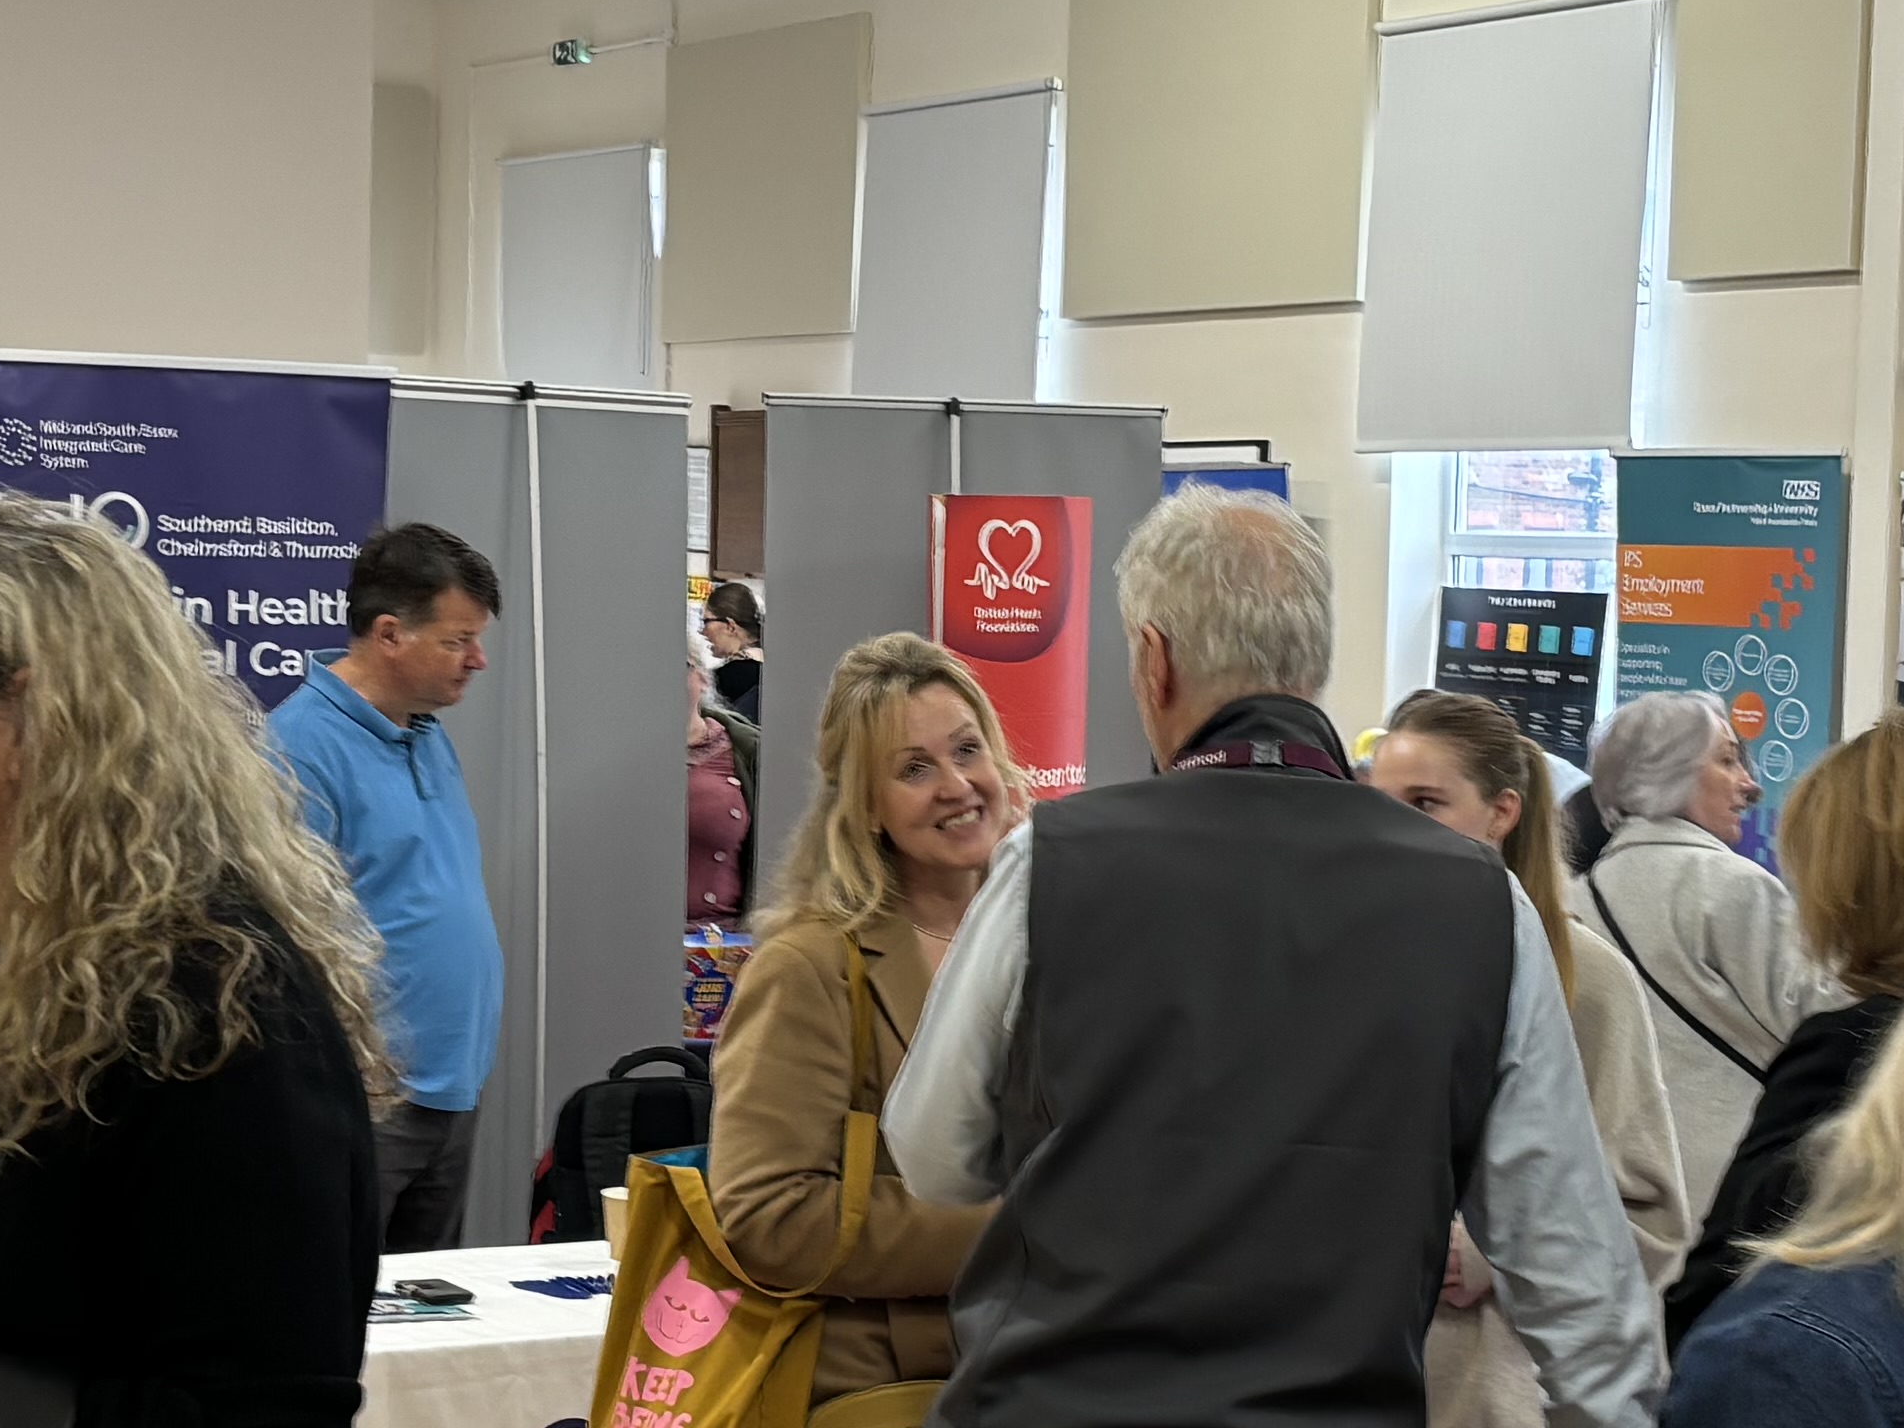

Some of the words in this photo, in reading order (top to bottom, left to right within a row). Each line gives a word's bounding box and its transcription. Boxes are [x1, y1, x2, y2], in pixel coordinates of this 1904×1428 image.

[39, 453, 90, 471] System
[156, 537, 267, 559] Chelmsford
[267, 540, 284, 559] &
[1622, 574, 1705, 598] Employment
[248, 640, 306, 678] Ca
[619, 1355, 696, 1407] KEEP
